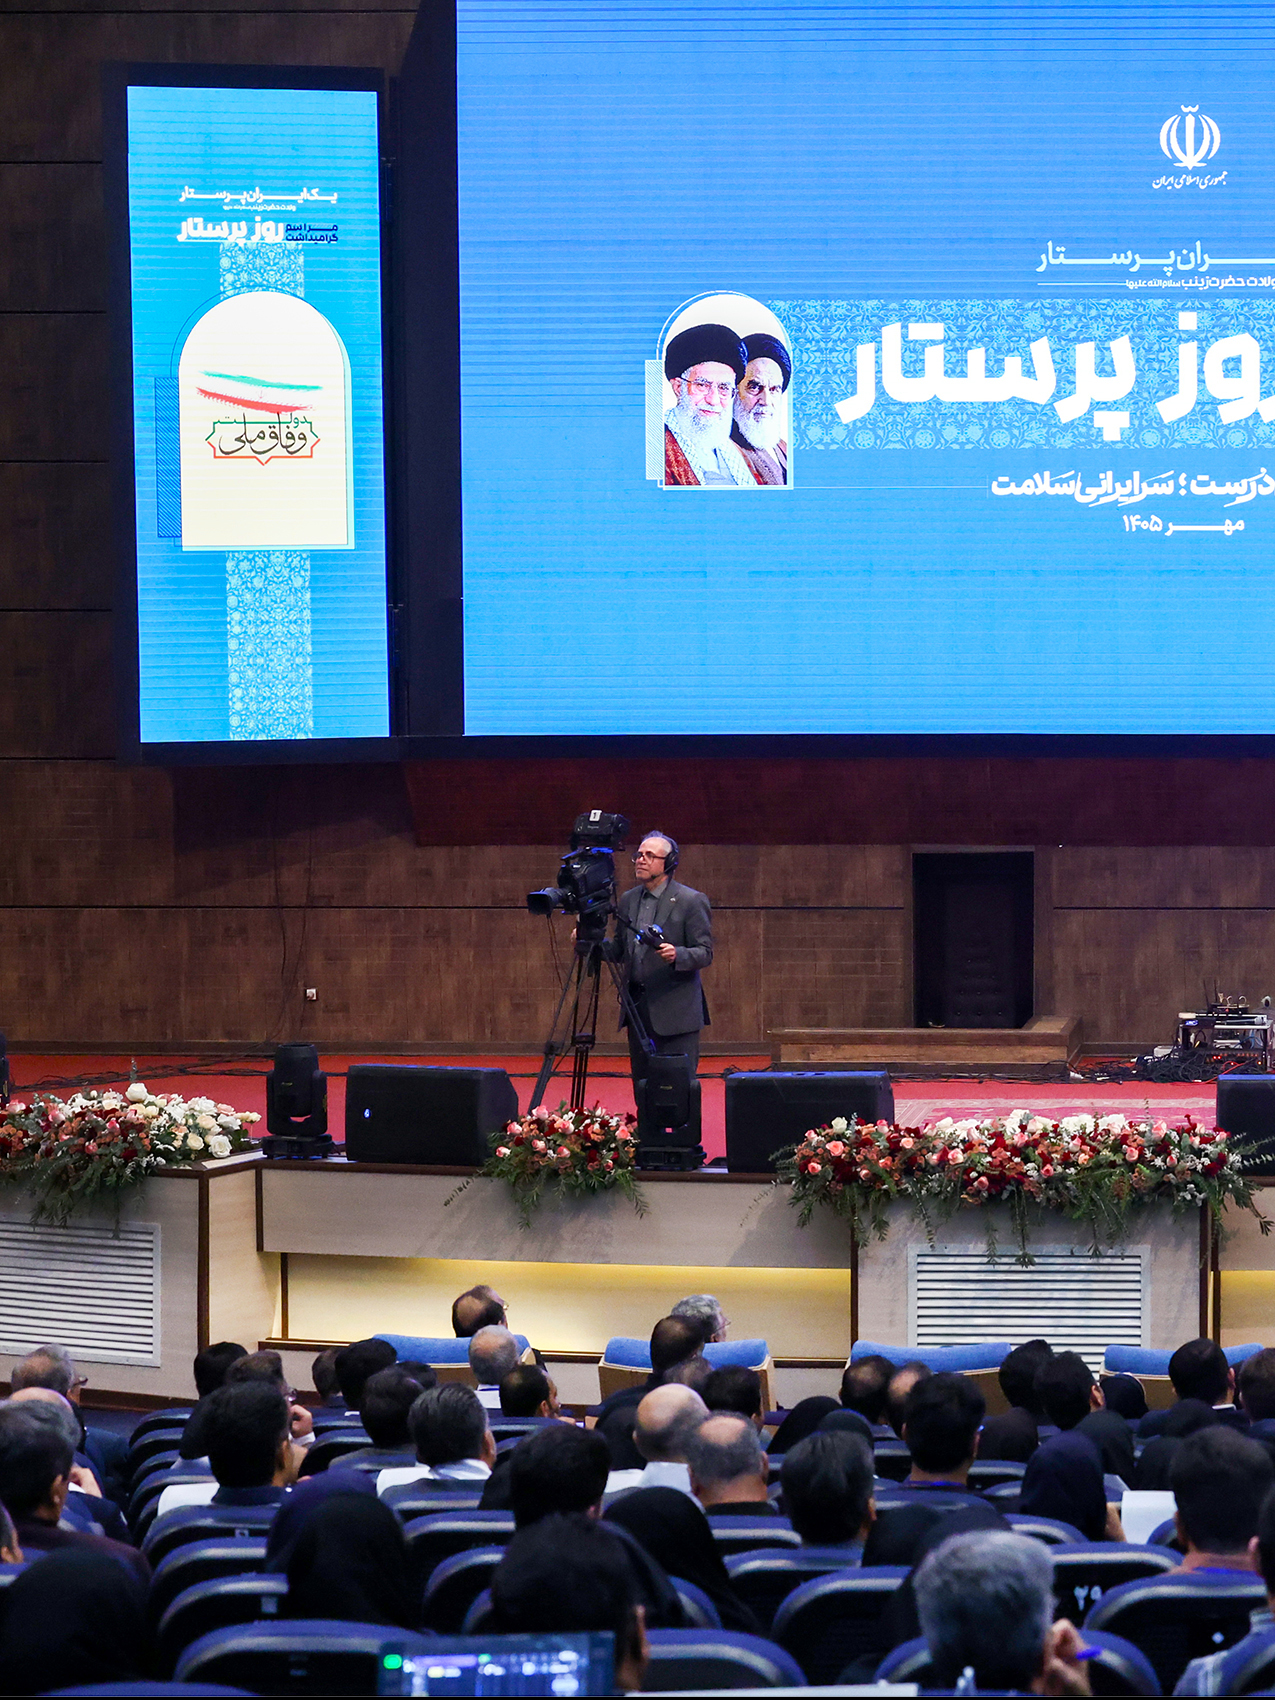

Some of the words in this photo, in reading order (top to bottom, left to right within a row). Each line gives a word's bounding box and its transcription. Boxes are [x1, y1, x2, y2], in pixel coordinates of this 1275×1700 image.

[1152, 175, 1175, 190] ایران
[1174, 174, 1200, 189] اسلامی
[1199, 171, 1228, 190] جمهوری
[179, 185, 247, 205] پرستار
[246, 186, 307, 204] ایران
[307, 187, 338, 204] یک
[176, 217, 248, 248] پرستار
[250, 215, 284, 242] روز
[285, 223, 338, 233] مراسم
[1035, 240, 1176, 277] پرستار
[1181, 275, 1209, 291] زینب
[1209, 274, 1246, 290] حضرت
[834, 322, 1137, 442] پرستار
[1074, 470, 1140, 507] ایرانی
[1123, 514, 1163, 532] ۱۴۰۵
[1165, 517, 1245, 536] مهر
